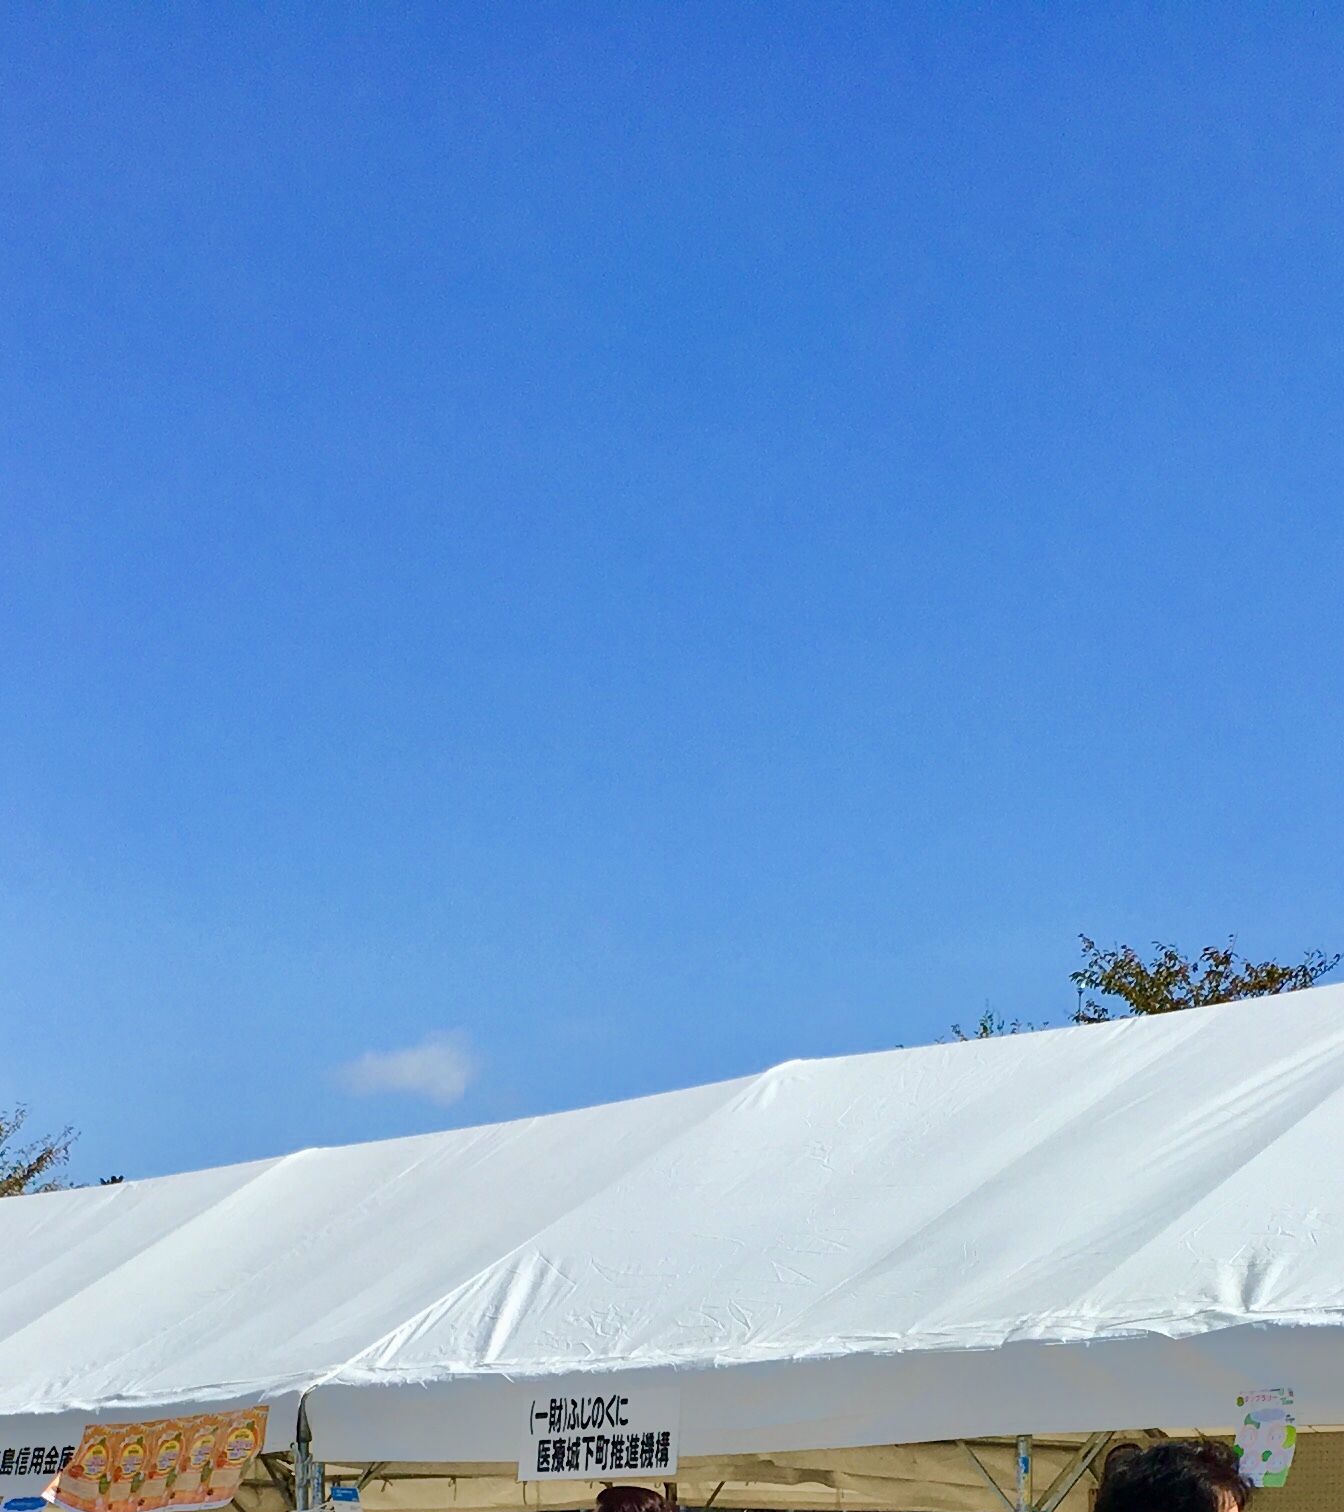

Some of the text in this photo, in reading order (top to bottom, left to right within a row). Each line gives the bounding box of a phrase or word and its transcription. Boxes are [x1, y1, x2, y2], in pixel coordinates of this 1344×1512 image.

[529, 1394, 629, 1435] (一財)ふじのくに
[536, 1431, 670, 1473] 医療城下町推進機構
